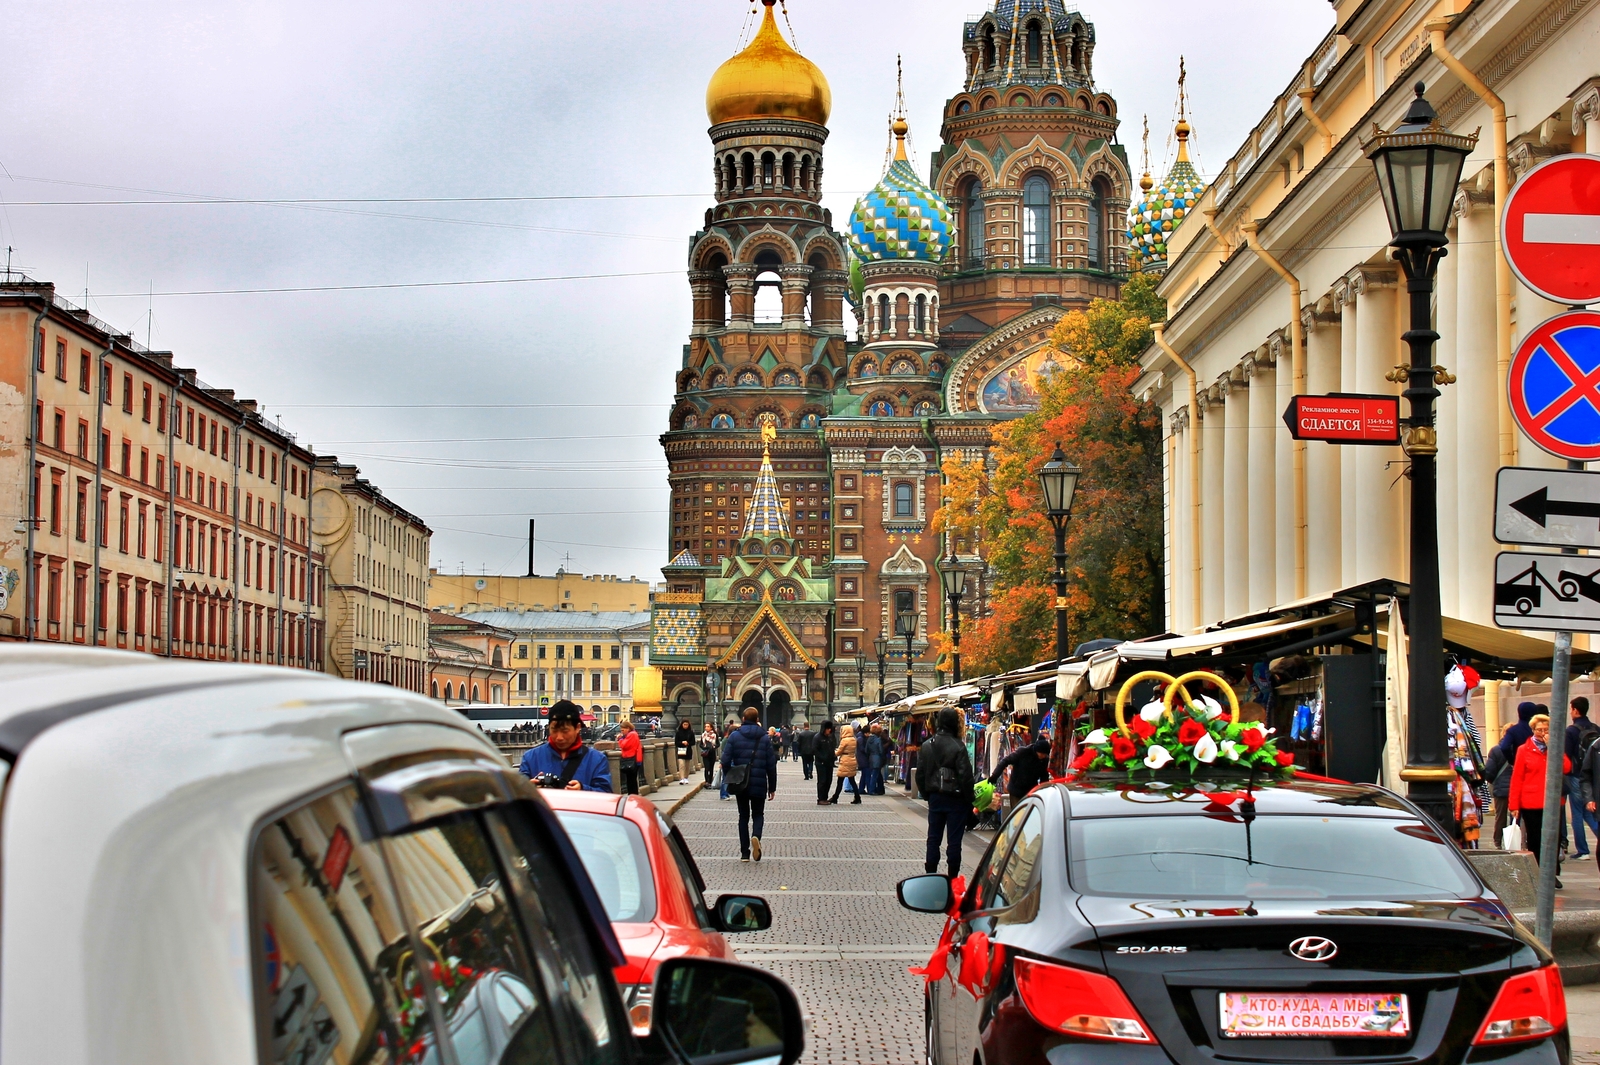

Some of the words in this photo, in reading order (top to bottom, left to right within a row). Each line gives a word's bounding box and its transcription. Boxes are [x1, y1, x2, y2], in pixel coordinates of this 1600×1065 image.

[1301, 405, 1339, 413] Рекламное
[1300, 418, 1361, 431] СДАЕТСЯ
[1115, 946, 1188, 954] SOLARIS
[1249, 998, 1324, 1013] КТО-КУДА,
[1329, 998, 1339, 1012] А
[1343, 998, 1370, 1012] МЫ
[1267, 1015, 1286, 1027] НА
[1291, 1015, 1360, 1029] СВАДЬБУ
